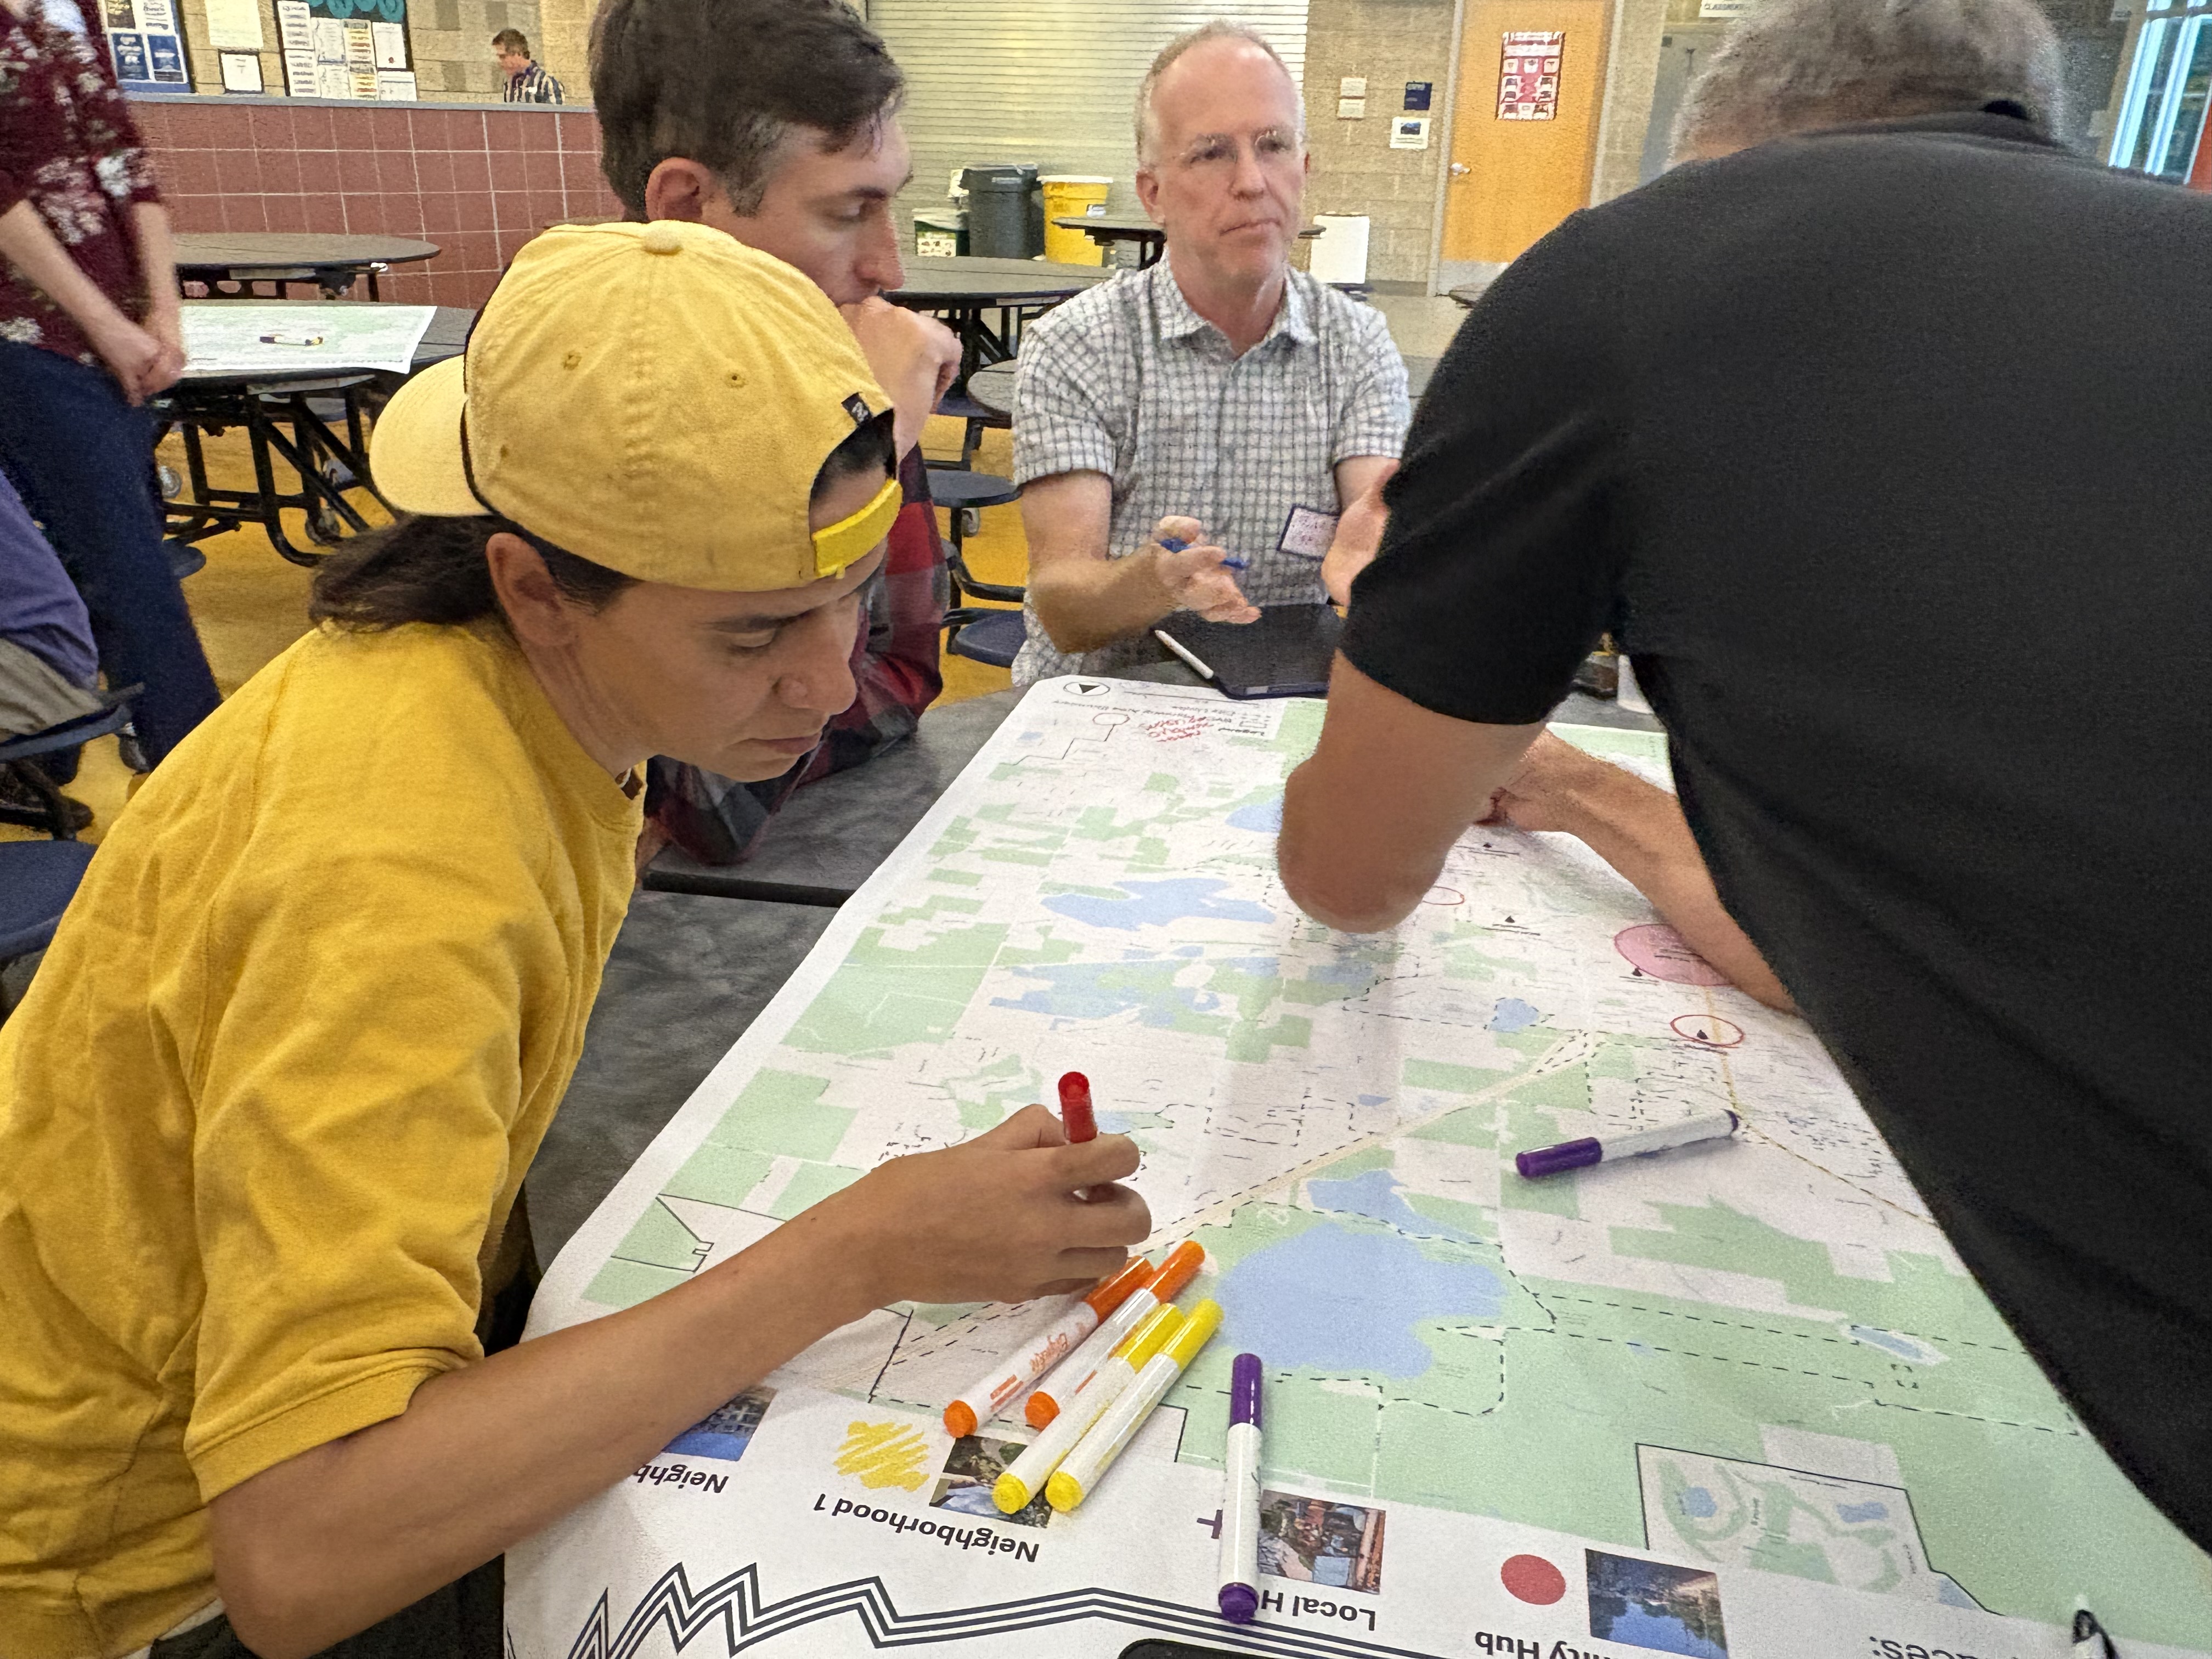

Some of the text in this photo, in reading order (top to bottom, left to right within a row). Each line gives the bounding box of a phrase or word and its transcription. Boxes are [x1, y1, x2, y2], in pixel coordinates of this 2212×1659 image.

[633, 1464, 729, 1493] Neighb
[814, 1493, 1040, 1563] Neighborhood 1
[1292, 1595, 1375, 1631] Local
[1475, 1631, 1539, 1659] Hub
